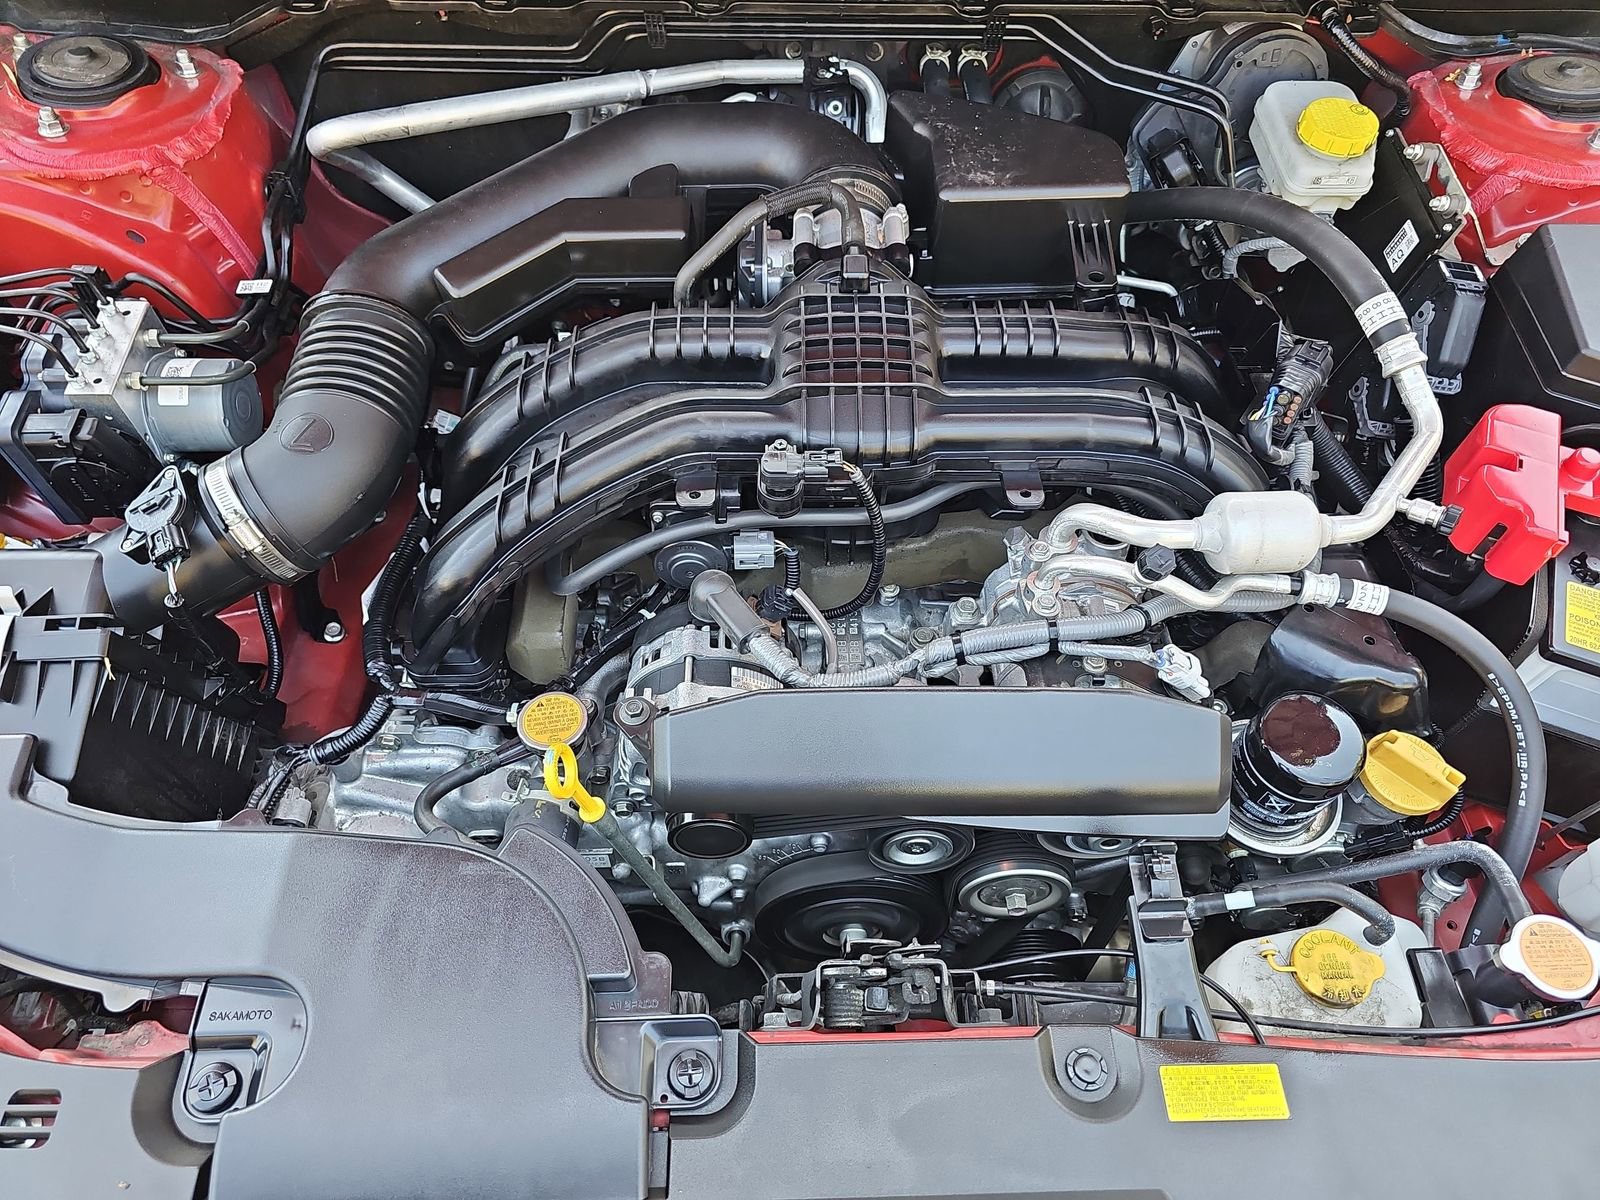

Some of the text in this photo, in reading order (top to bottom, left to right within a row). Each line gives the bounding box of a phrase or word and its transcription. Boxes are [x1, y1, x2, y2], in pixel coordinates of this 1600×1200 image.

[1392, 249, 1405, 267] AQ
[1569, 584, 1600, 599] DANGE
[1299, 932, 1360, 959] COOLANT
[1323, 984, 1367, 1001] 冷却水
[208, 1010, 273, 1021] SAKAMOTO
